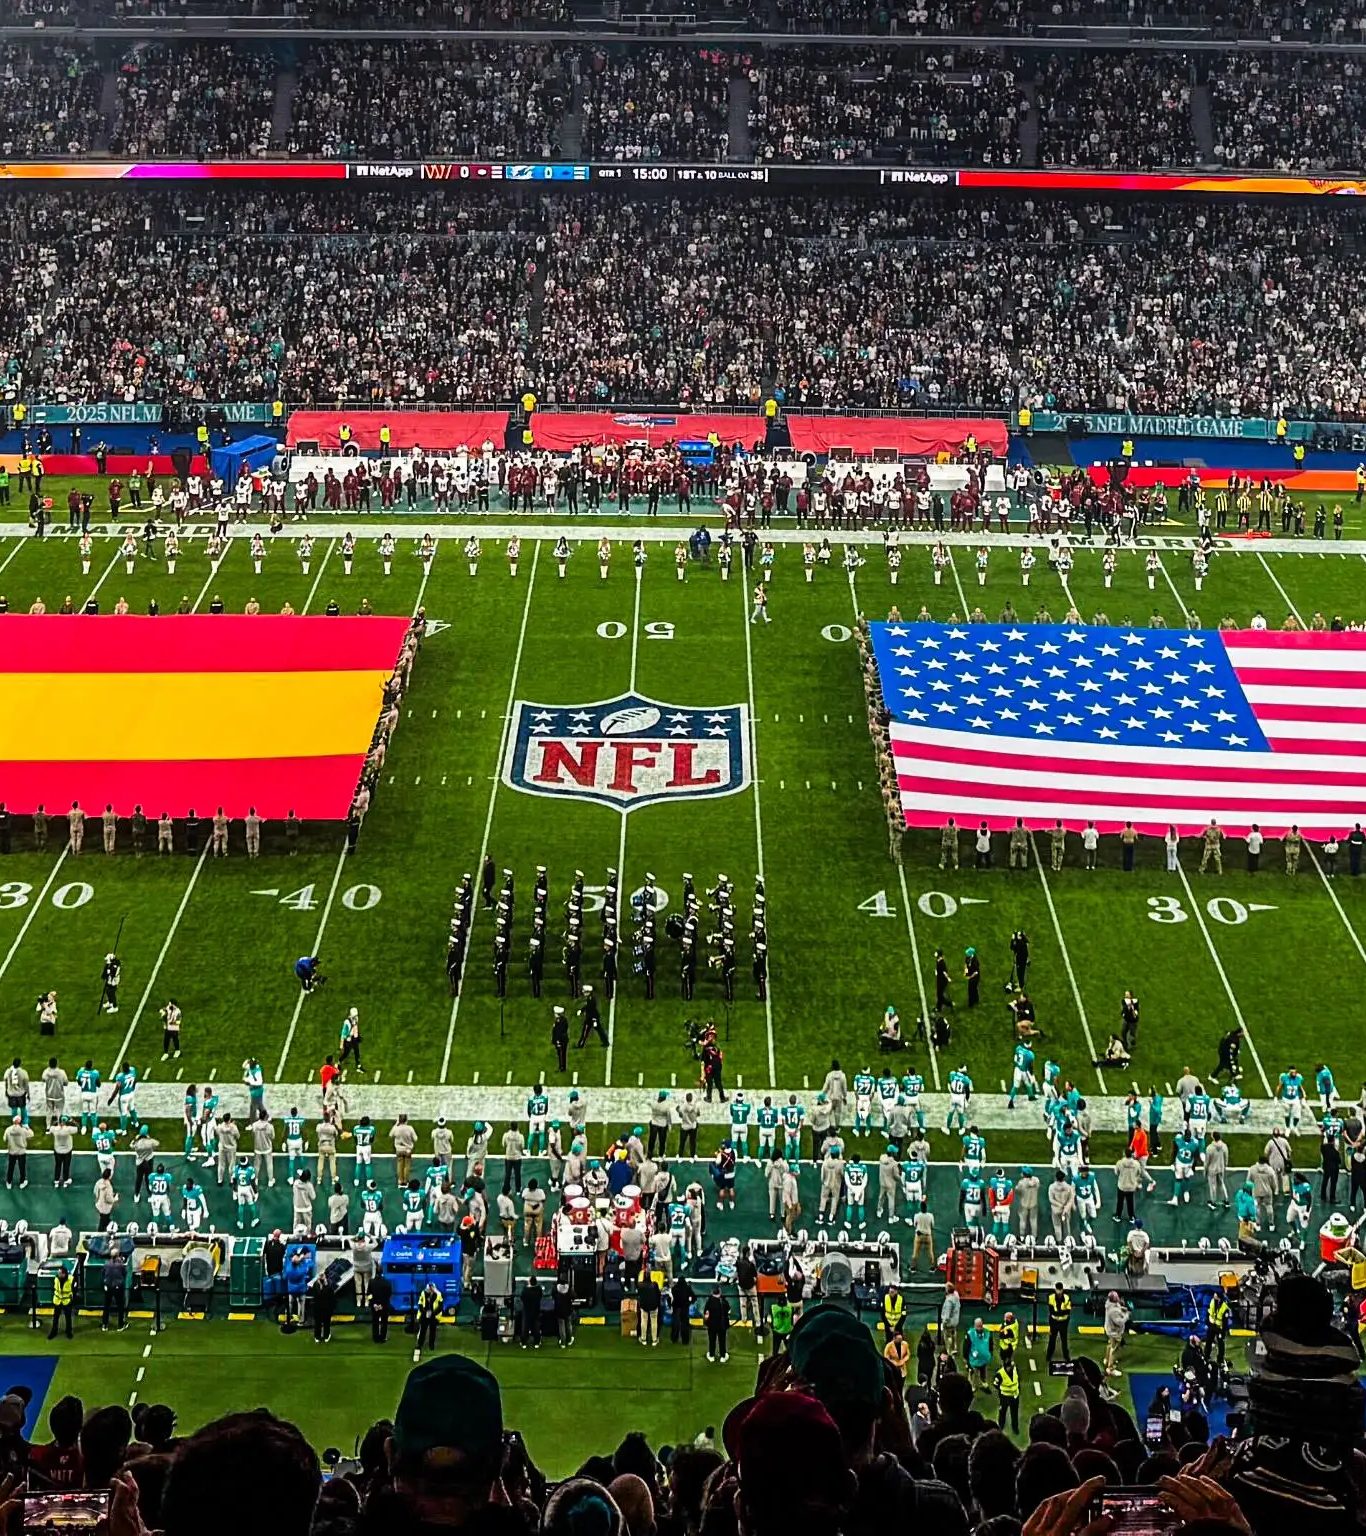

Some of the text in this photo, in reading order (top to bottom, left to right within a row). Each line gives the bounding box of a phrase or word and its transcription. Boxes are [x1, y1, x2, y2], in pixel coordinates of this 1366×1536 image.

[370, 165, 414, 178] NetApp
[632, 168, 668, 180] 15:00
[904, 171, 949, 184] NetApp
[66, 406, 107, 422] 2025
[110, 406, 137, 422] NFL
[1096, 416, 1126, 433] NFL
[1129, 417, 1192, 435] MADRID
[1197, 420, 1244, 437] GAME
[532, 740, 721, 794] NFL
[279, 882, 383, 913] 40
[857, 890, 958, 918] 40
[1145, 895, 1250, 925] 30
[738, 1111, 743, 1121] 1
[152, 1180, 167, 1192] 30
[996, 1187, 1004, 1201] 8
[671, 1212, 685, 1225] 23
